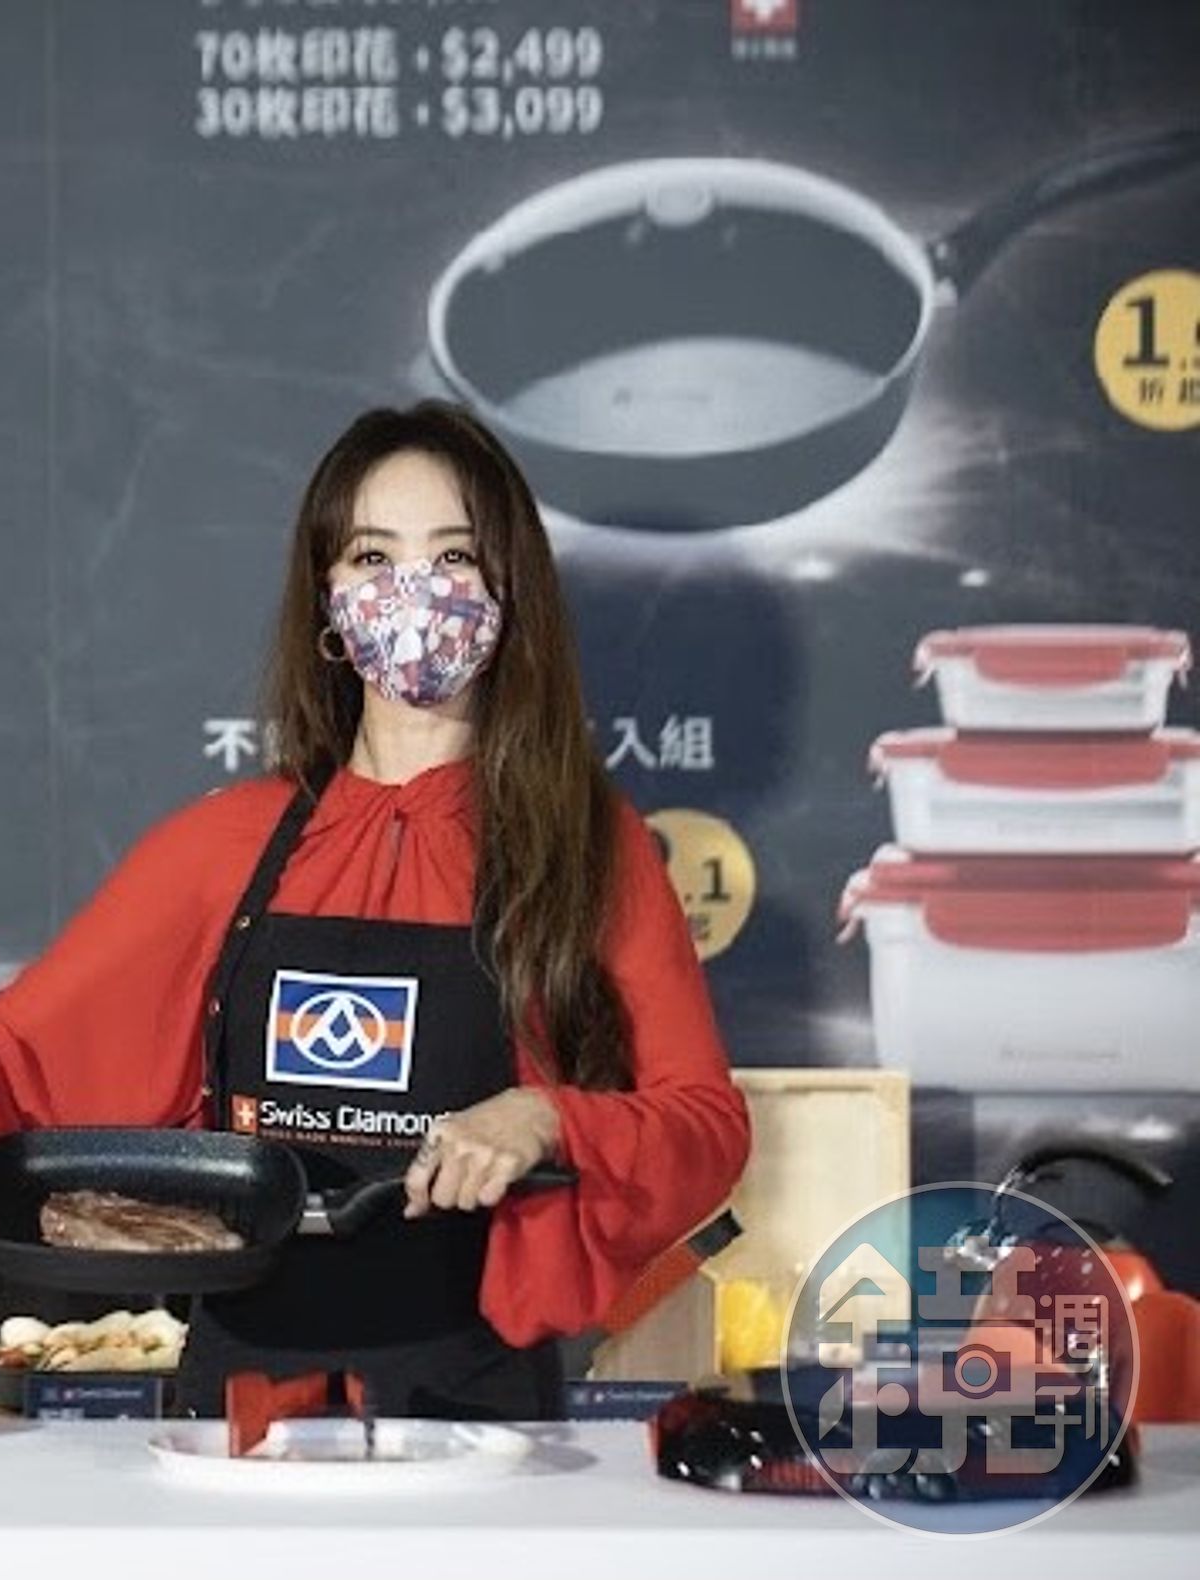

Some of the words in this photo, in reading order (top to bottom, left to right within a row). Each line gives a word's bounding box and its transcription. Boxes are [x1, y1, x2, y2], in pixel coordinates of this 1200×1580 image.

[605, 714, 716, 771] 入組
[260, 1101, 331, 1130] Swiss
[337, 1105, 449, 1136] Diamon
